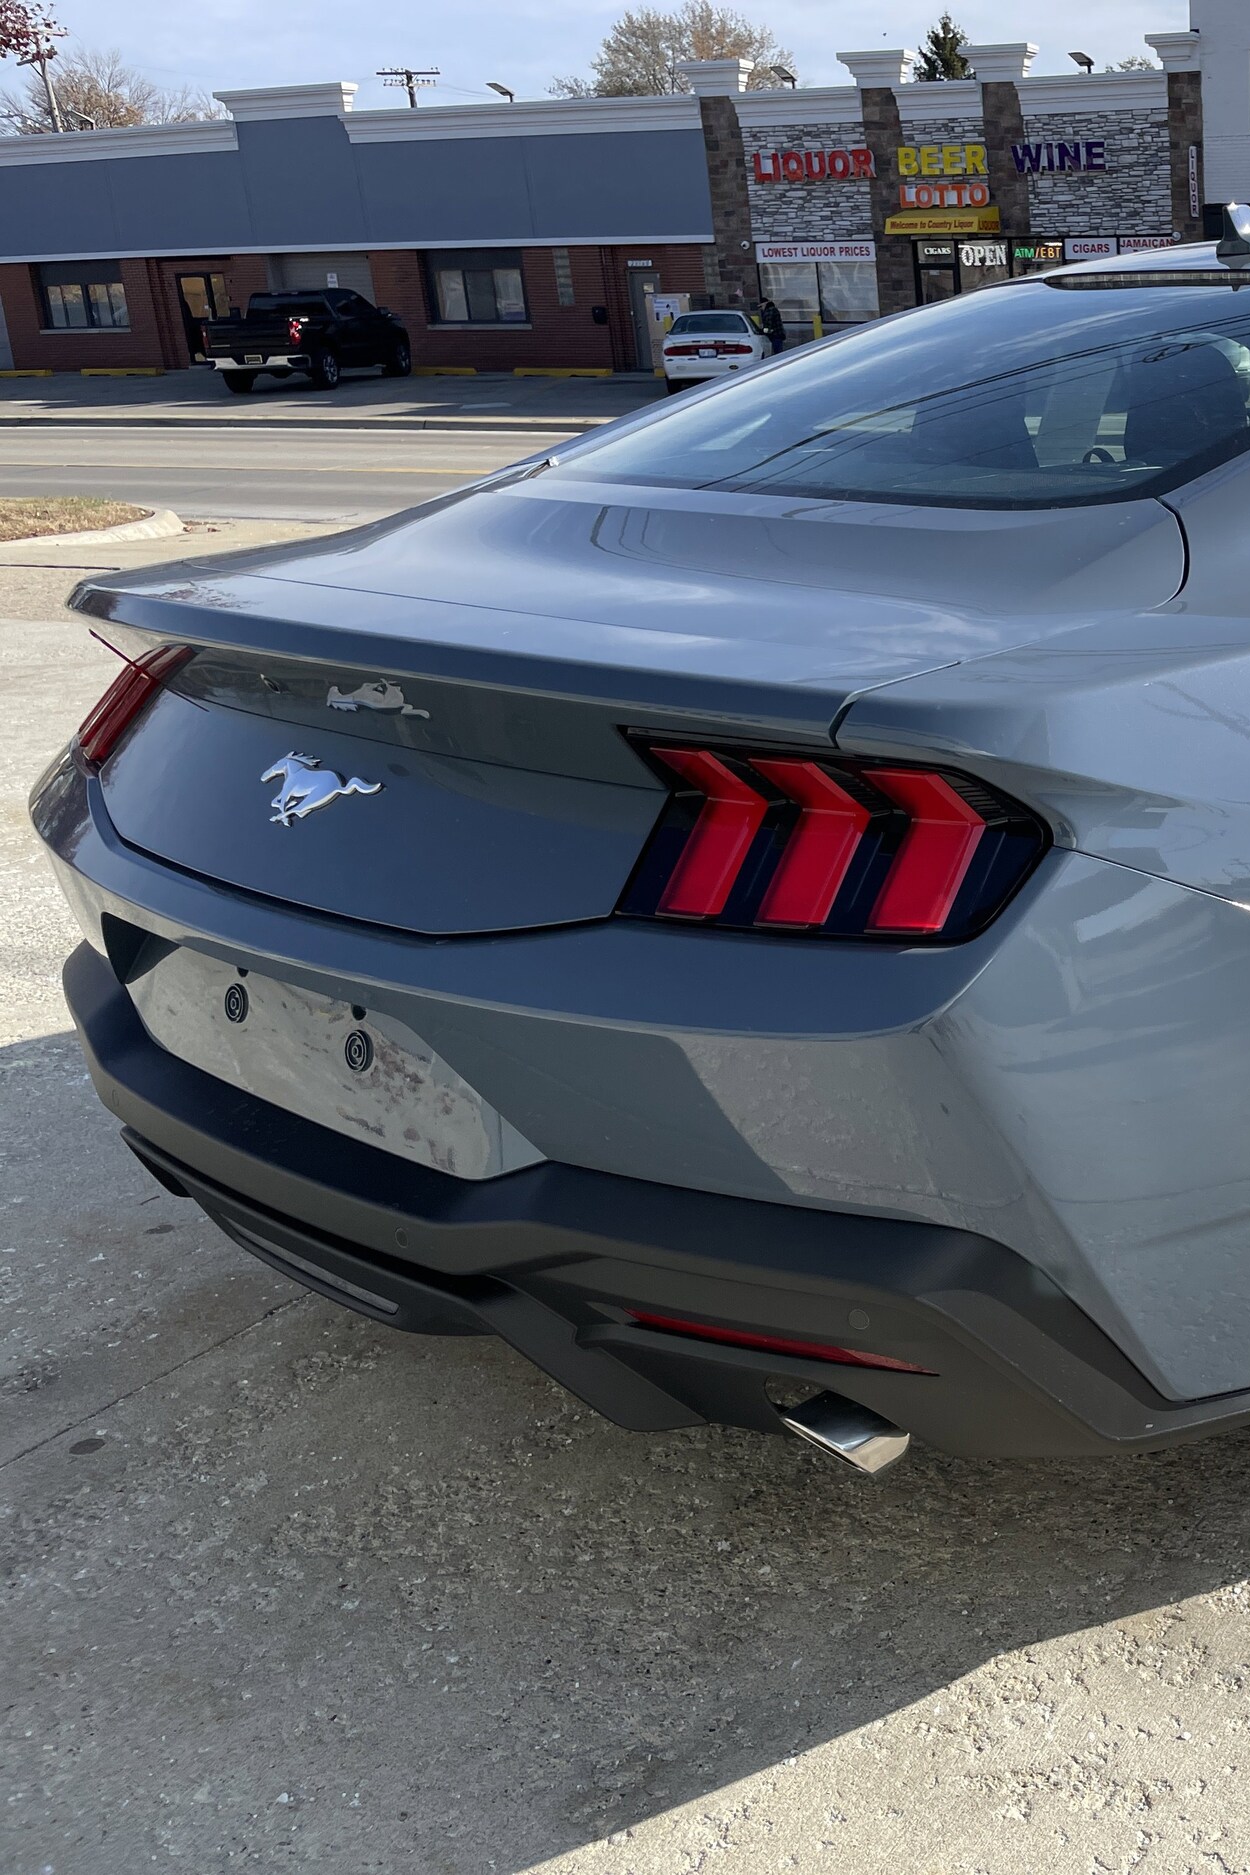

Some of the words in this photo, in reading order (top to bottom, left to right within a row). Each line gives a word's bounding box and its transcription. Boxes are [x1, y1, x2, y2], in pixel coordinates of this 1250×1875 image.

[897, 145, 990, 175] BEER
[1010, 141, 1107, 172] WINE
[752, 149, 877, 183] LIQUOR
[1189, 150, 1198, 214] LIQUOR
[899, 183, 990, 208] LOTTO
[890, 220, 918, 229] Welcome
[920, 220, 926, 228] to
[928, 219, 952, 230] Country
[954, 220, 974, 229] Liquor
[762, 247, 798, 257] LOWEST
[801, 247, 836, 257] LIQUOR
[839, 246, 871, 256] PRICES
[924, 247, 951, 255] CIGARS
[1072, 243, 1110, 253] CIGARS
[1120, 239, 1175, 248] JAMAICAN
[961, 245, 1007, 266] OPEN
[1014, 246, 1061, 259] ATM/EBT
